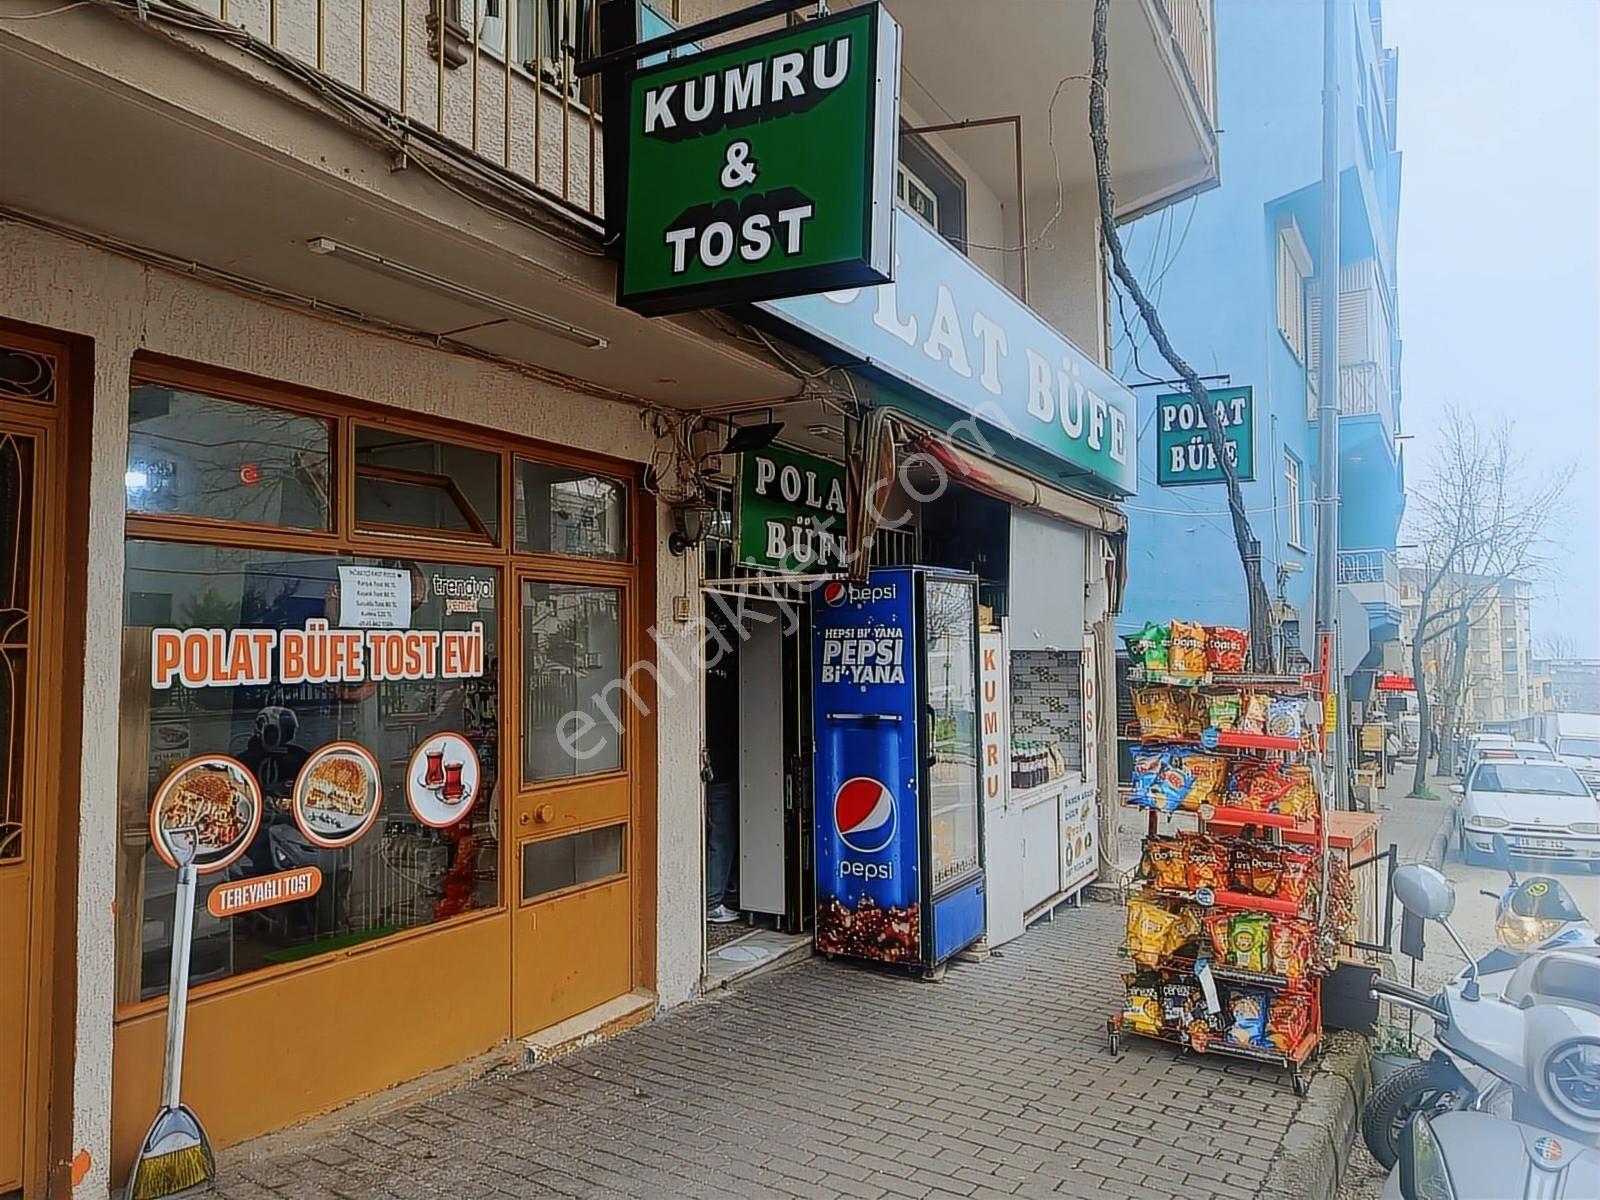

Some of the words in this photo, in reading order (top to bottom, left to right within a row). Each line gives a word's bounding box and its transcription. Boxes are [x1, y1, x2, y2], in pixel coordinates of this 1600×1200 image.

[645, 38, 849, 133] KUMRU
[721, 141, 757, 188] &
[666, 205, 812, 272] TOST
[1026, 348, 1127, 466] BÜFE
[433, 575, 494, 599] trendyol
[849, 583, 896, 604] pepsi
[874, 627, 903, 638] YANA
[154, 630, 275, 686] POLAT
[282, 621, 363, 681] BÜFE
[366, 631, 437, 678] TOST
[443, 623, 482, 676] EVİ
[823, 639, 904, 666] PEPSI
[850, 665, 905, 684] YANA
[984, 649, 999, 798] KUMRU
[1083, 647, 1094, 763] TOST
[284, 873, 312, 896] TOST
[840, 860, 892, 881] pepsi
